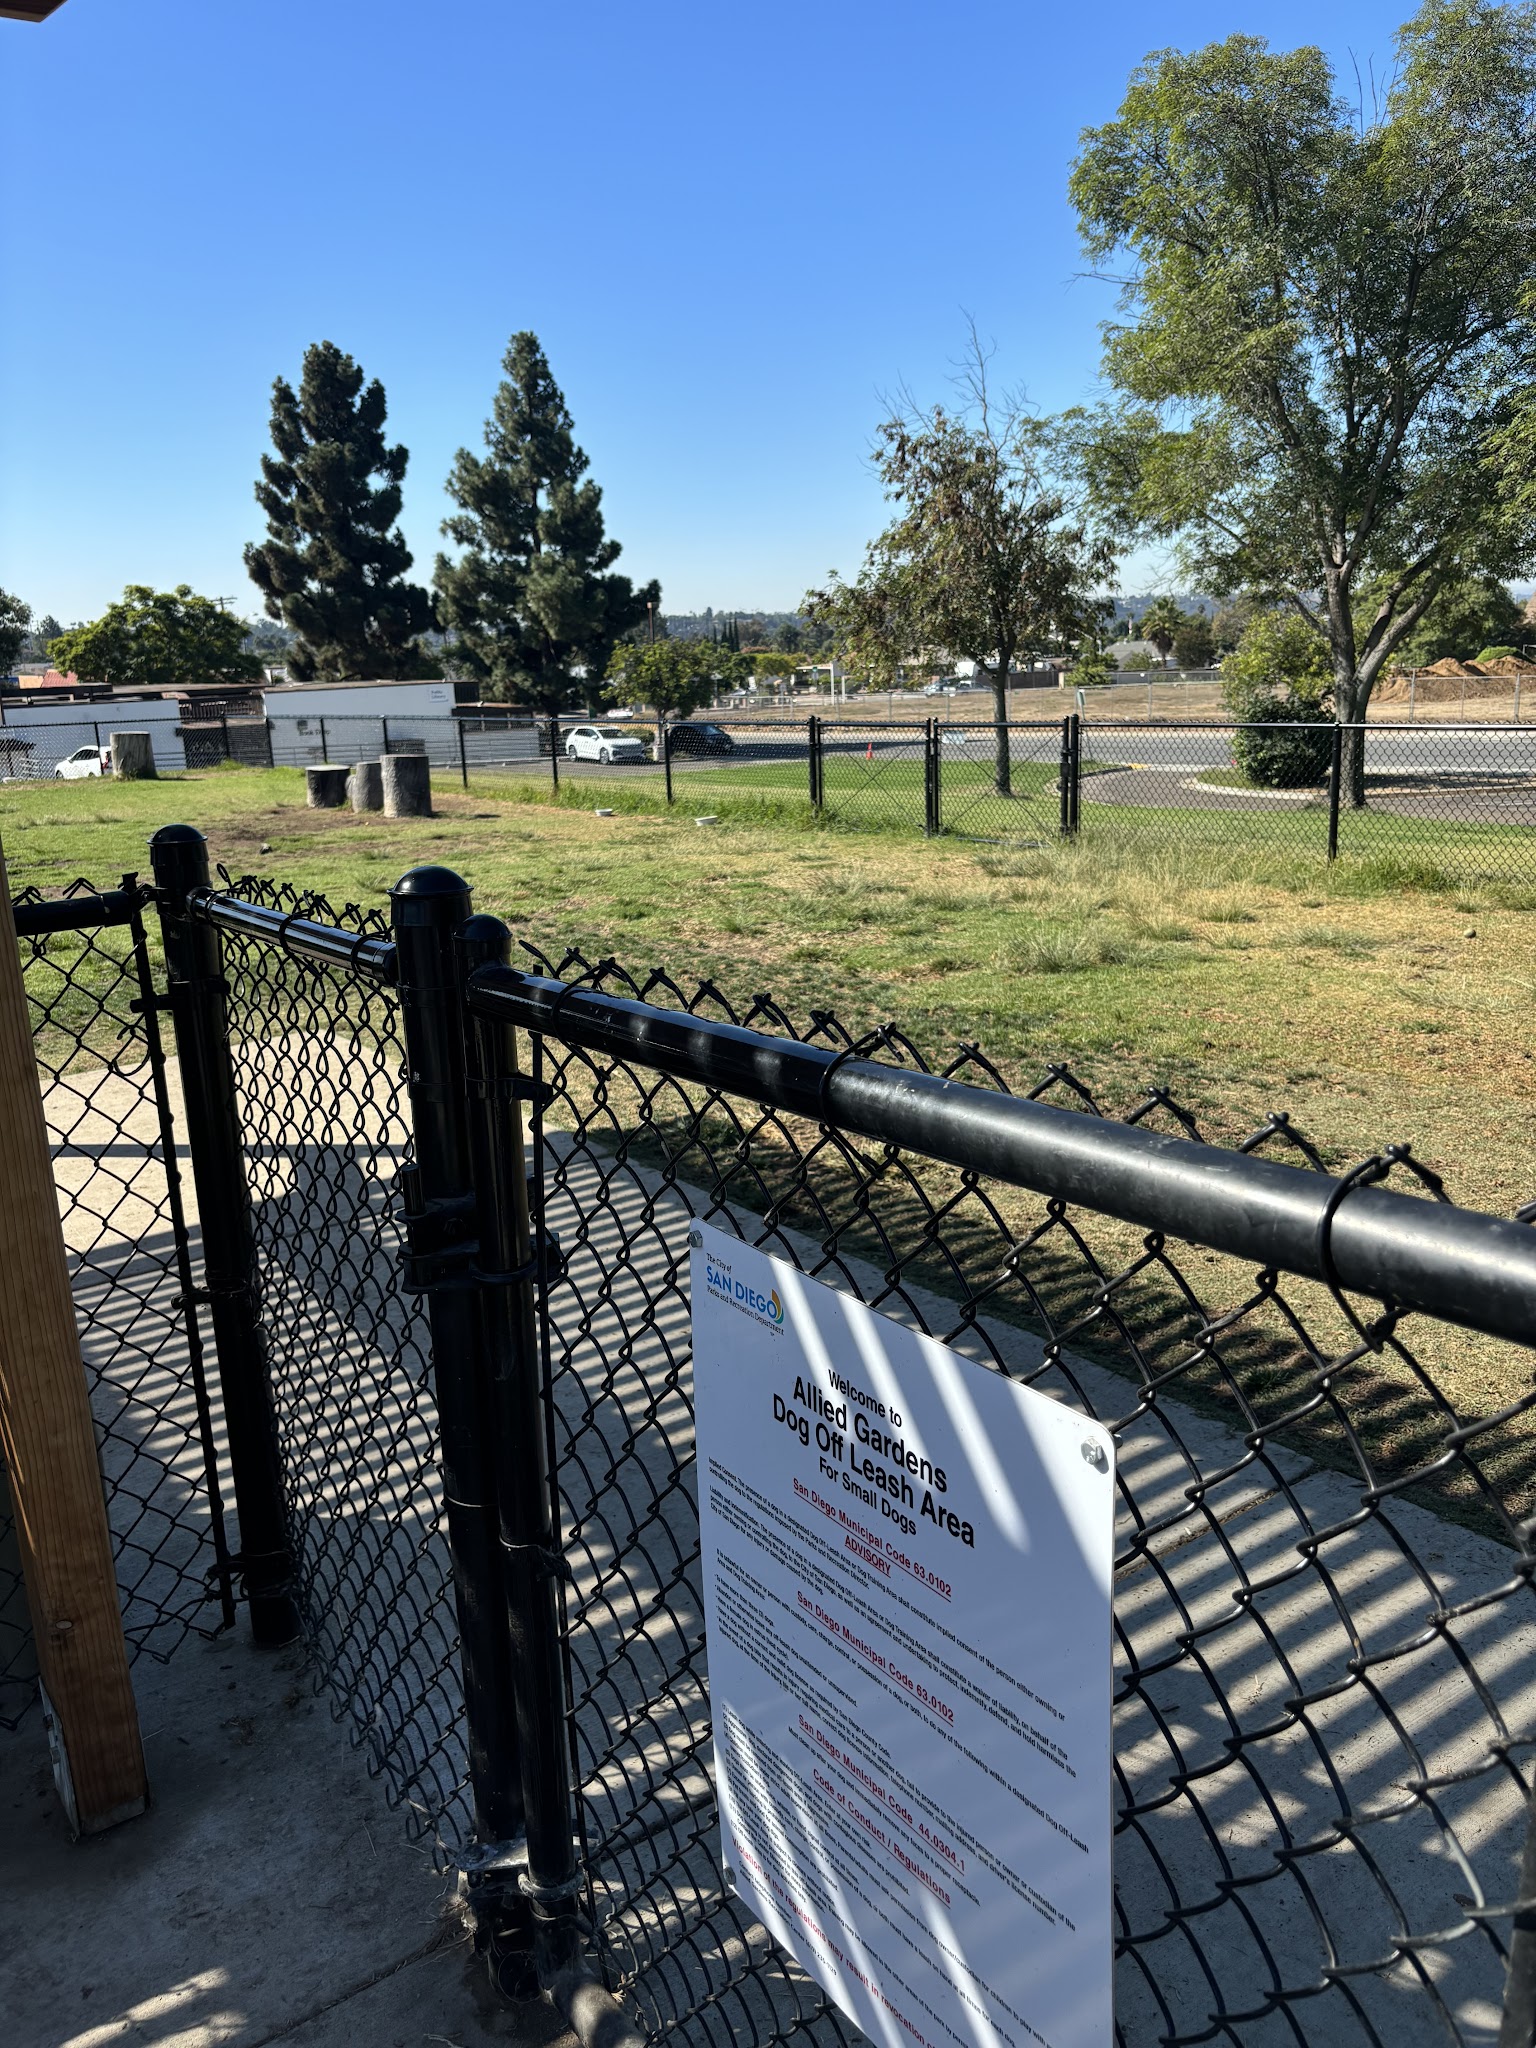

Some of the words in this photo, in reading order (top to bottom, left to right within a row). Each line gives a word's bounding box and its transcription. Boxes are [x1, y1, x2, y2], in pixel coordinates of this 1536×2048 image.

[706, 1265, 732, 1294] SAN
[735, 1281, 778, 1320] DIEGO
[707, 1285, 720, 1298] Parks
[719, 1293, 730, 1304] and
[729, 1298, 755, 1319] Recreation
[754, 1312, 784, 1336] Department
[793, 1375, 847, 1432] Allied
[853, 1412, 948, 1493] Gardens
[828, 1369, 886, 1418] Welcome
[888, 1406, 903, 1428] to
[773, 1392, 810, 1447] Dog
[815, 1422, 844, 1463] Off
[850, 1442, 914, 1510] Leash
[919, 1489, 975, 1549] Area
[819, 1455, 839, 1483] For
[842, 1471, 878, 1510] Small
[881, 1497, 917, 1536] Dogs
[793, 1477, 809, 1498] San
[811, 1490, 837, 1517] Diego
[838, 1509, 883, 1550] Municipal
[885, 1542, 911, 1569] Code
[913, 1562, 952, 1598] 63.0102
[844, 1534, 891, 1575] ADVISORY
[797, 1590, 813, 1611] San
[815, 1604, 840, 1632] Diego
[842, 1625, 886, 1669] Municipal
[888, 1662, 914, 1690] Code
[916, 1684, 954, 1723] 63.0102
[798, 1714, 814, 1736] San
[816, 1729, 841, 1759] Diego
[842, 1753, 886, 1801] Municipal
[888, 1794, 913, 1825] Code
[918, 1822, 965, 1872] 44.0304.1
[813, 1768, 835, 1796] Code
[836, 1792, 846, 1806] of
[847, 1800, 886, 1844] Conduct
[887, 1837, 891, 1848] /
[893, 1842, 951, 1904] Regulations
[731, 1834, 762, 1874] Violation
[763, 1871, 771, 1884] of
[771, 1879, 784, 1898] the
[785, 1894, 827, 1942] regulations
[827, 1938, 844, 1962] may
[845, 1958, 869, 1987] result
[871, 1982, 879, 1998] in
[881, 1995, 925, 2045] revocation
